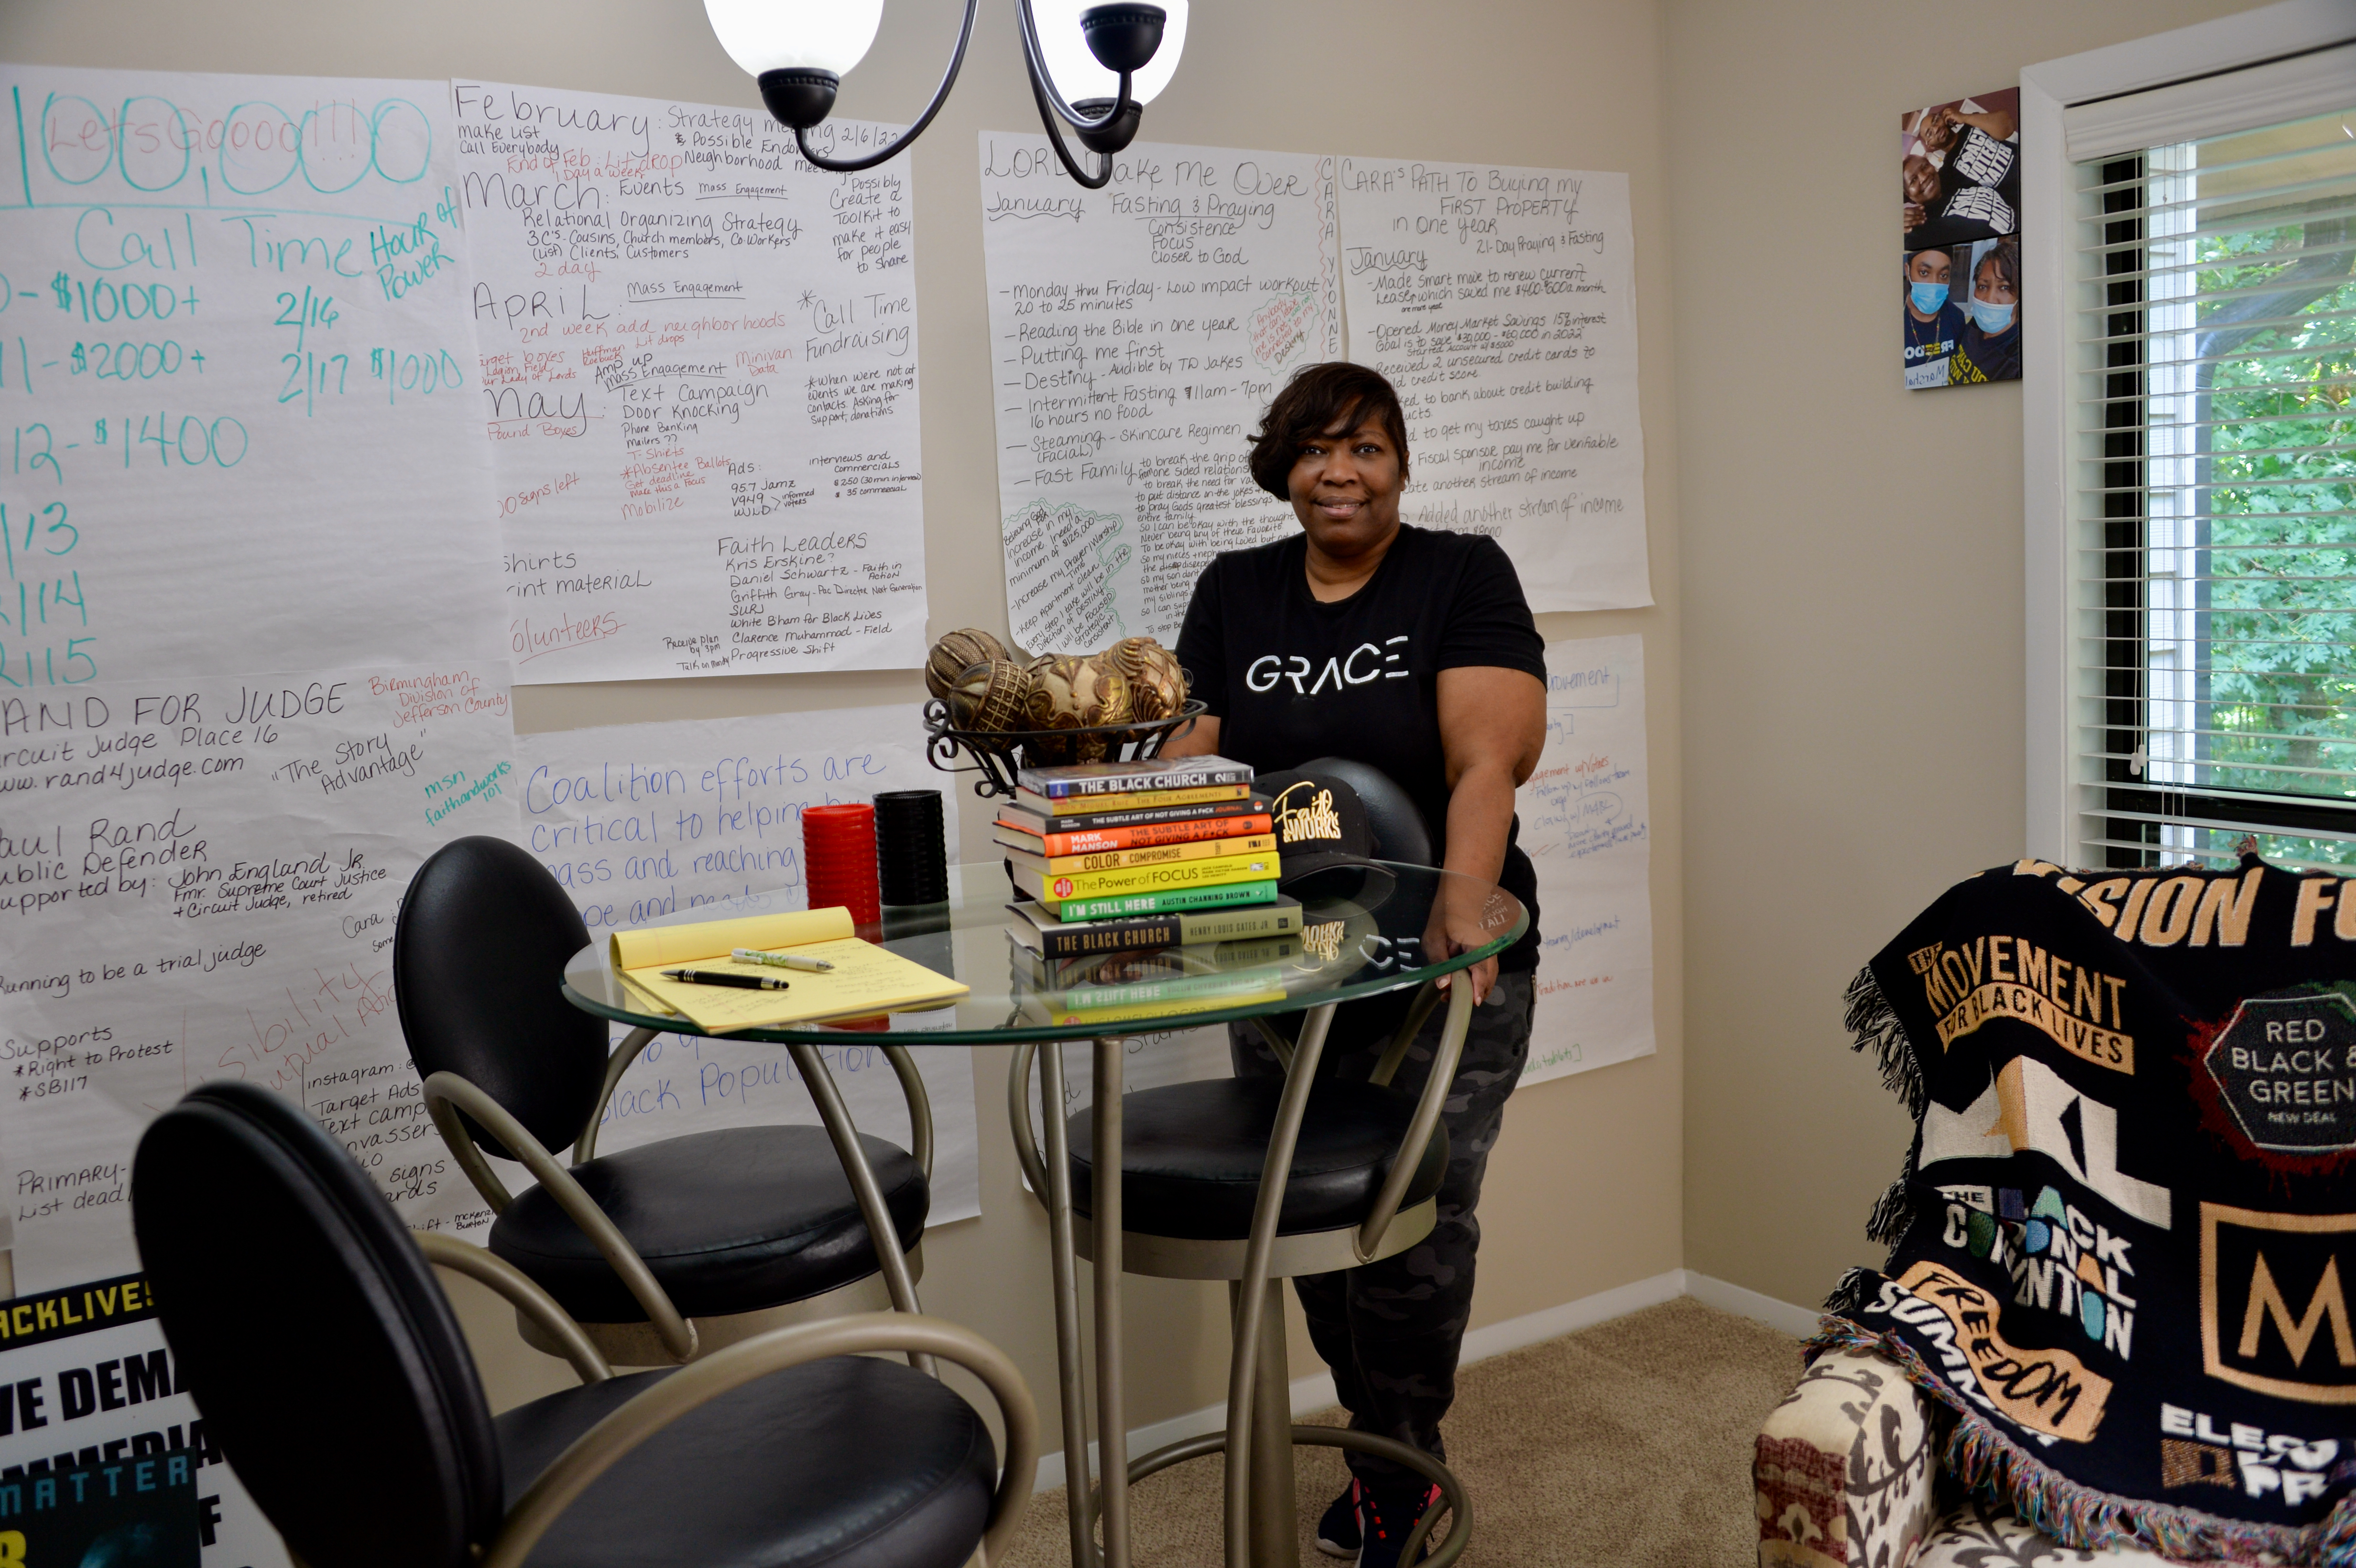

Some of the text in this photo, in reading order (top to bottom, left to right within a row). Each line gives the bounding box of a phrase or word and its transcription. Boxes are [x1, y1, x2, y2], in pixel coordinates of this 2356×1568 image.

[685, 150, 782, 171] Neighborhood
[523, 208, 610, 227] Relational
[987, 191, 1085, 221] January
[76, 207, 196, 271] Call
[861, 240, 901, 260] people
[626, 245, 689, 259] Customers
[1198, 248, 1249, 265] to God
[1346, 247, 1428, 271] January
[1014, 298, 1133, 316] 20 to 25 minutes
[1084, 315, 1144, 337] the Bible
[806, 323, 909, 362] Fundraising
[1021, 340, 1165, 369] Putting first
[1025, 370, 1097, 390] Destiny
[1473, 377, 1594, 399] about credit building
[851, 405, 894, 421] donations
[1049, 404, 1153, 425] hours no food
[1487, 412, 1584, 434] taxes caught up
[1081, 462, 1137, 485] Family
[718, 535, 774, 556] Faith
[731, 574, 773, 588] Daniel
[1246, 636, 1409, 694] GRACE
[135, 693, 201, 725] FOR
[254, 724, 278, 743] 16
[336, 733, 392, 764] Story
[526, 752, 886, 815] Coalition efforts are
[1079, 781, 1105, 793] THE
[1109, 777, 1152, 791] BLACK
[1154, 773, 1207, 788] CHURCH
[1106, 815, 1130, 823] SUBTLE
[1273, 781, 1339, 834] Faith
[90, 808, 196, 852] Rand
[531, 812, 703, 853] critical to
[1071, 833, 1102, 844] MARK
[1131, 837, 1151, 846] NOT
[1155, 833, 1189, 844] GIVING
[1153, 822, 1189, 835] SUBTLE
[1193, 821, 1212, 829] ART
[1072, 840, 1118, 853] MANSON
[624, 845, 799, 887] and reaching
[1084, 848, 1181, 870] COLOR COMPROMISE
[1074, 879, 1097, 891] The
[1099, 877, 1136, 888] Power
[1138, 872, 1150, 884] of
[1153, 868, 1198, 883] FOCUS
[1069, 891, 1250, 917] I'M STILL HERE AUSTIN CHANNING BROWN
[1057, 936, 1077, 952] THE
[1083, 932, 1119, 949] BLACK
[1125, 927, 1170, 946] CHURCH
[1190, 926, 1210, 936] HENRY
[1214, 924, 1233, 933] LOUIS
[79, 969, 94, 985] to
[104, 965, 125, 981] be
[157, 949, 201, 970] trial
[1924, 936, 2126, 1030] MOVEMENT
[1971, 986, 2043, 1024] BLACK
[2051, 1008, 2123, 1063] LIVES
[2266, 1019, 2325, 1043] RED
[86, 1041, 173, 1066] to Protest
[2232, 1047, 2334, 1073] BLACK
[2249, 1078, 2356, 1105] GREEN
[2268, 1112, 2337, 1123] NEW DEAL
[1911, 1271, 2082, 1427] FREEDOM
